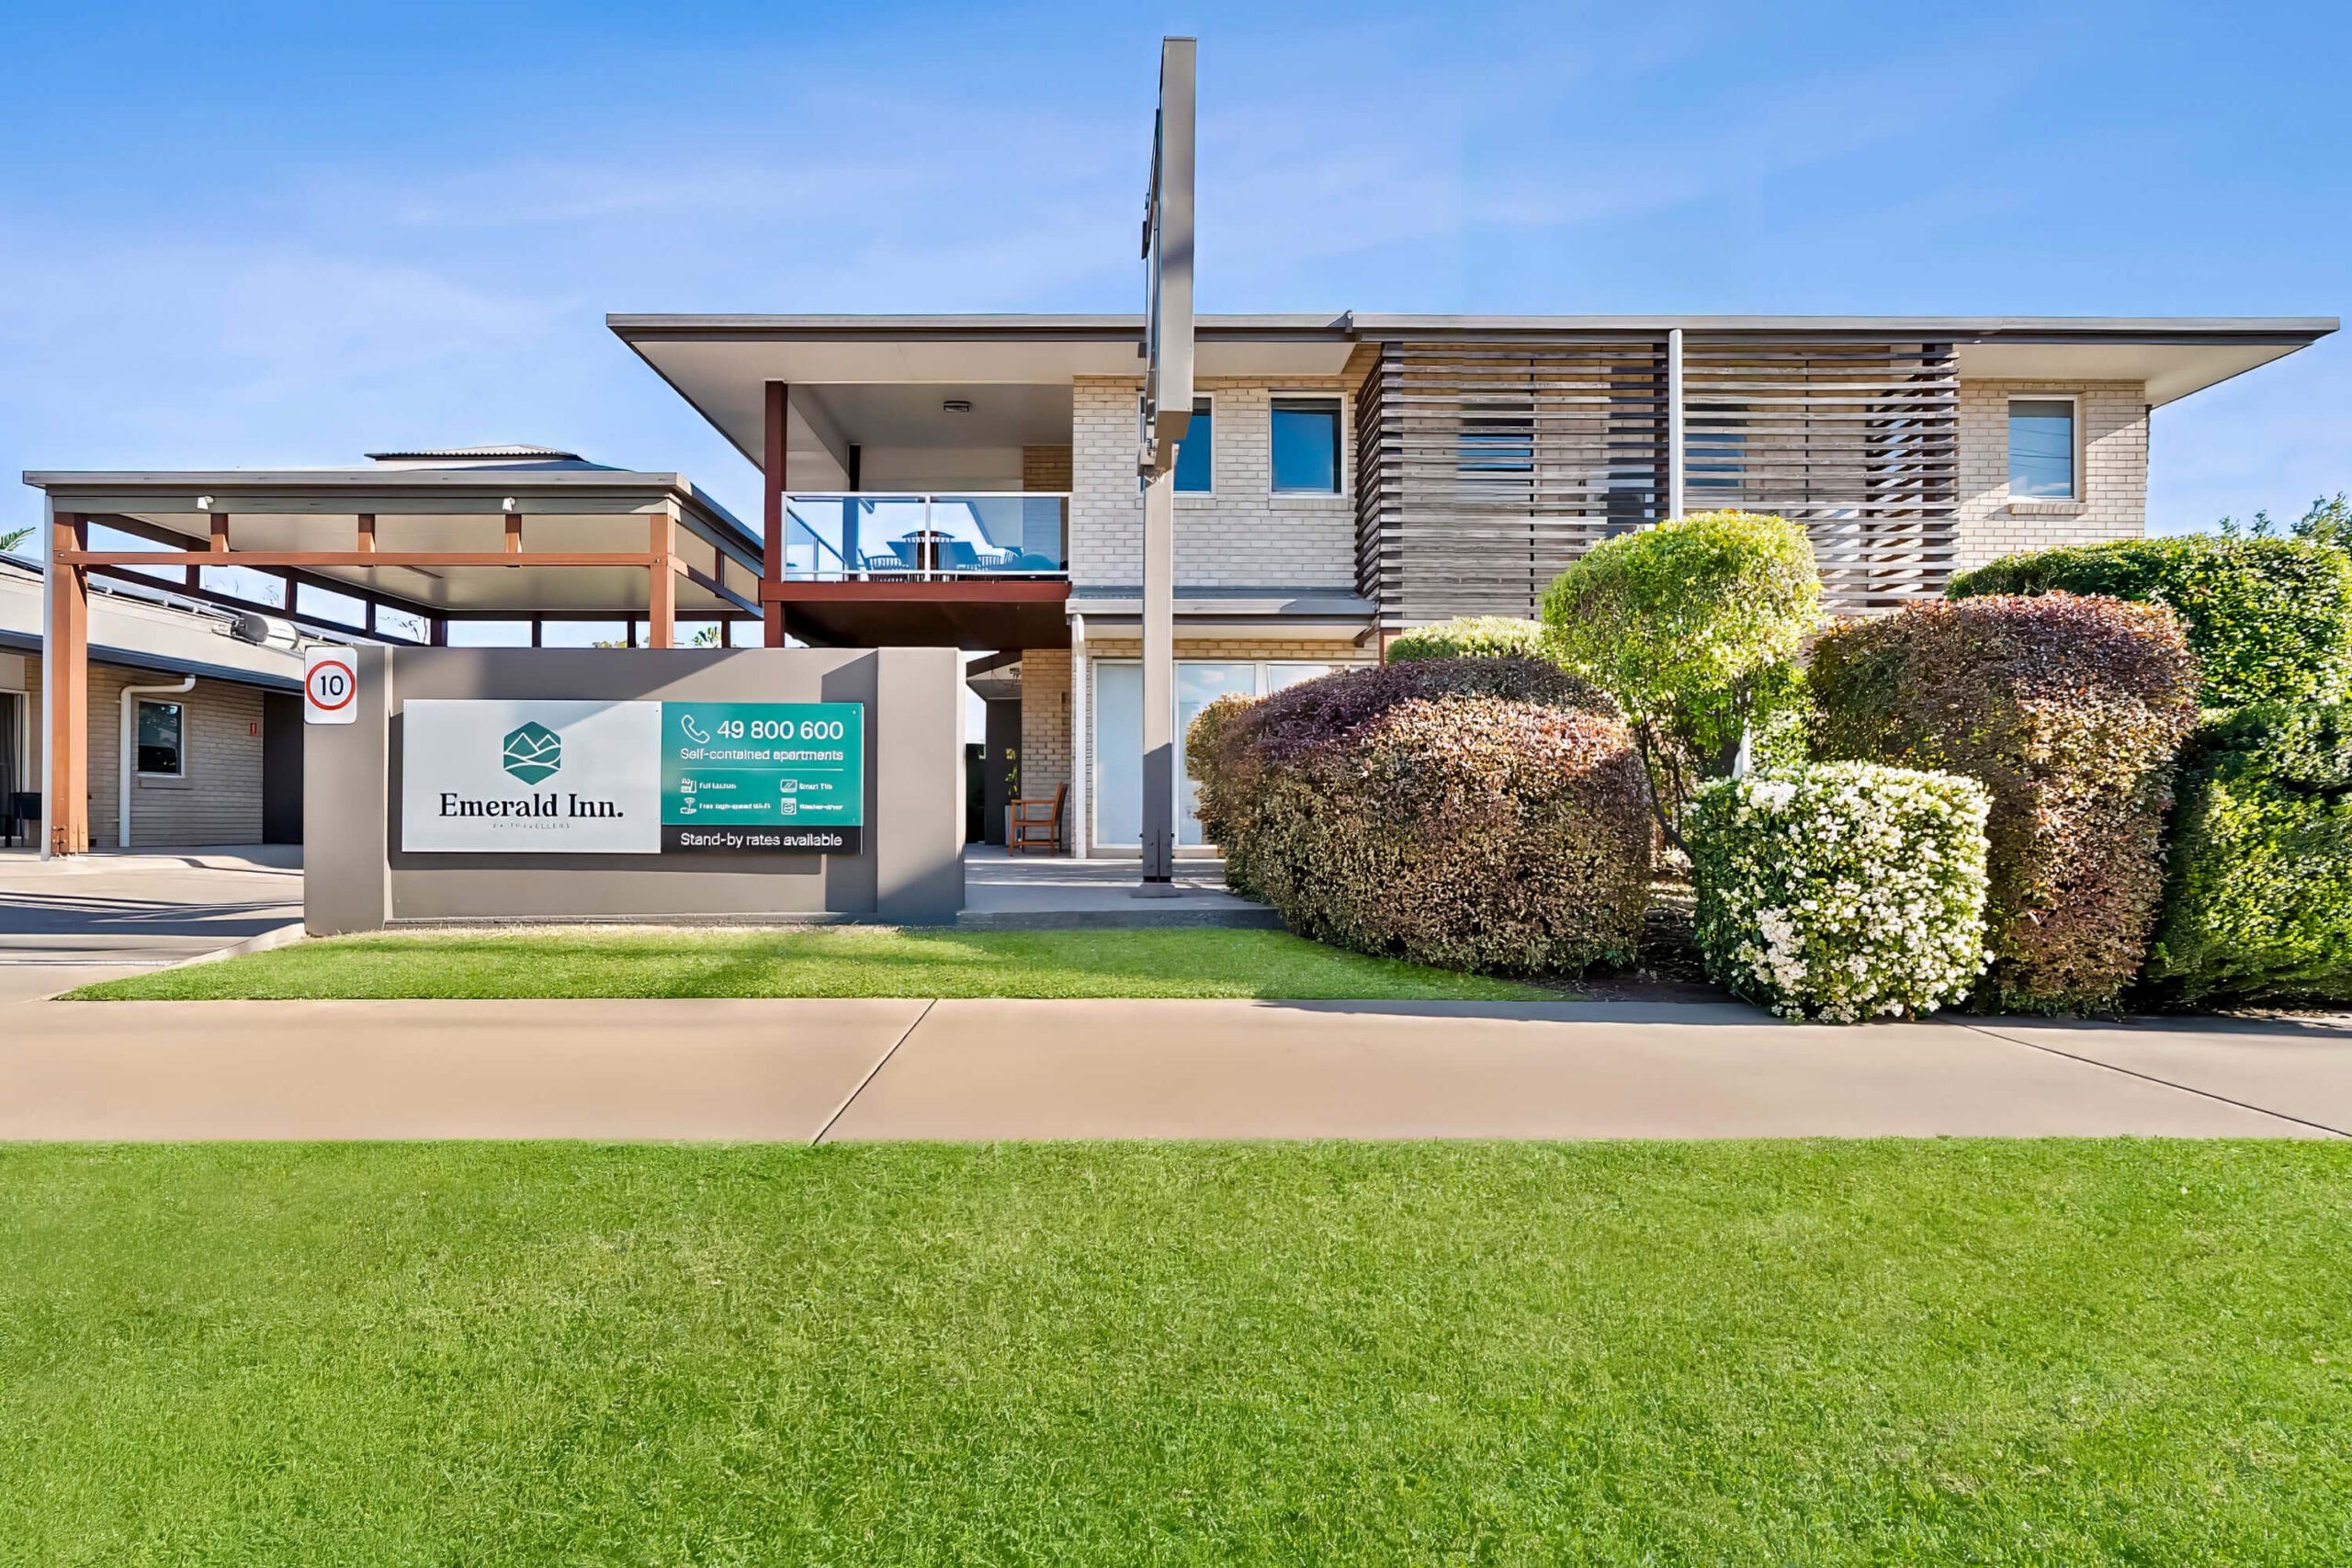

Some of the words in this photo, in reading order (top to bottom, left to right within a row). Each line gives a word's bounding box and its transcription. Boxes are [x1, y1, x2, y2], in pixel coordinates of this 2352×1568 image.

[321, 675, 344, 696] 10
[717, 720, 745, 739] 49
[751, 720, 795, 739] 800
[800, 721, 844, 739] 600
[681, 748, 770, 760] Self-contained
[774, 750, 843, 762] apartments
[438, 792, 559, 817] Emerald
[568, 793, 625, 818] Inn.
[681, 832, 743, 849] Stand-by
[746, 833, 781, 846] rates
[783, 833, 843, 846] available
